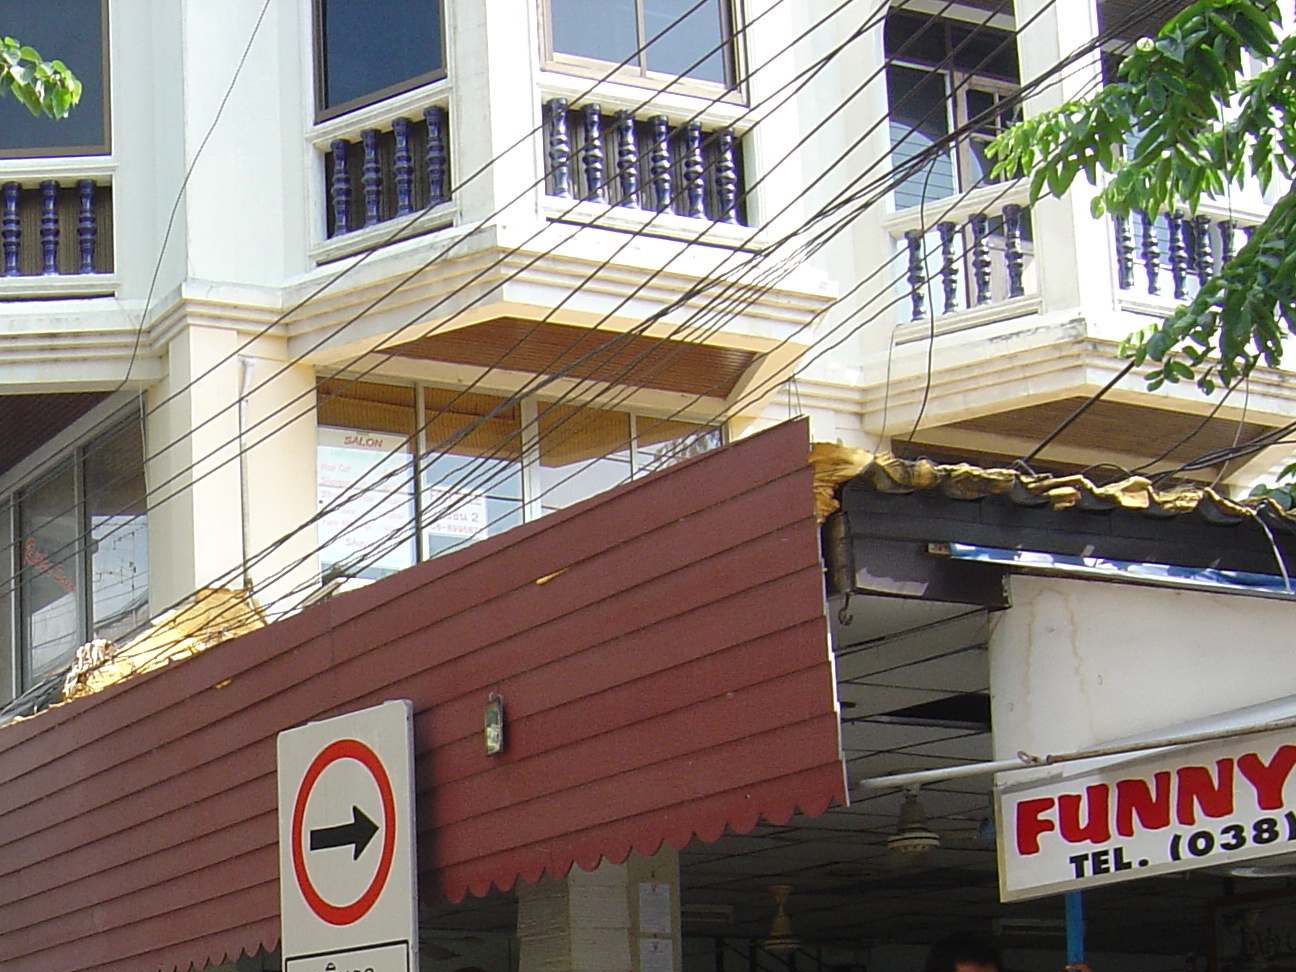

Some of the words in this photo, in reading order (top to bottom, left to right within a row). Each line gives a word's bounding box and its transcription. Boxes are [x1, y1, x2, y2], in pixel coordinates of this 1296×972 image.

[344, 435, 383, 448] SALON
[1016, 745, 1296, 856] FUNNY
[1069, 847, 1149, 879] TEL.
